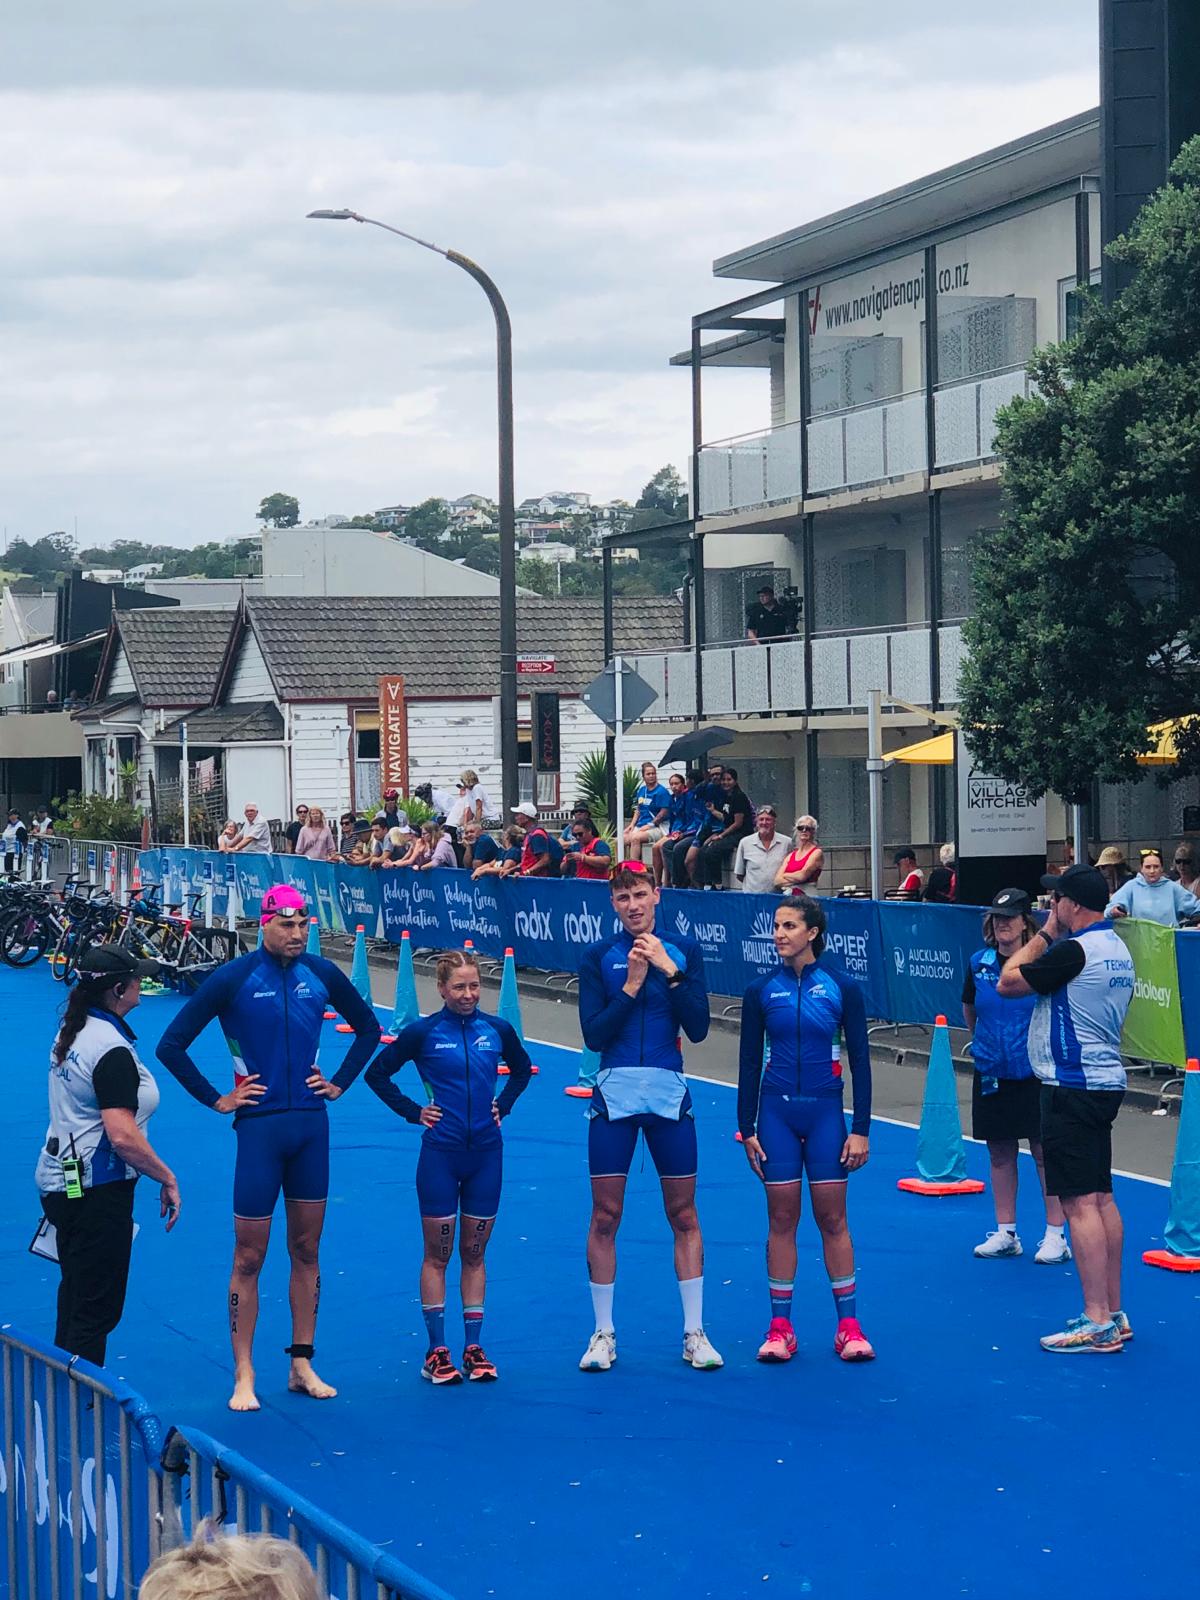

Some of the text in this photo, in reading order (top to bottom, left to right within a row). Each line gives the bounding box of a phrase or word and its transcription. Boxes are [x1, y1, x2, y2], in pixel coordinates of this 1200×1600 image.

[826, 262, 969, 329] www.navigatenapi.co.nz
[387, 704, 401, 782] NAVIGATE
[971, 786, 1027, 798] VILLAG
[970, 797, 1038, 809] KITCHEN
[350, 885, 365, 900] World
[383, 878, 435, 910] Rodney Green
[443, 880, 498, 915] Rodney Green
[351, 899, 374, 915] Triathlon
[385, 905, 440, 930] Foundation
[447, 910, 502, 939] Foundation
[515, 898, 554, 941] radix
[563, 900, 603, 943] radix
[694, 922, 727, 943] NAPIER
[908, 947, 951, 963] AUCKLAND
[845, 956, 868, 972] PORT
[909, 963, 954, 980] RADIOLOGY
[1133, 977, 1172, 1008] diology
[441, 1223, 450, 1235] 8
[476, 1219, 487, 1231] 8
[230, 1292, 239, 1306] 8
[231, 1321, 238, 1334] A
